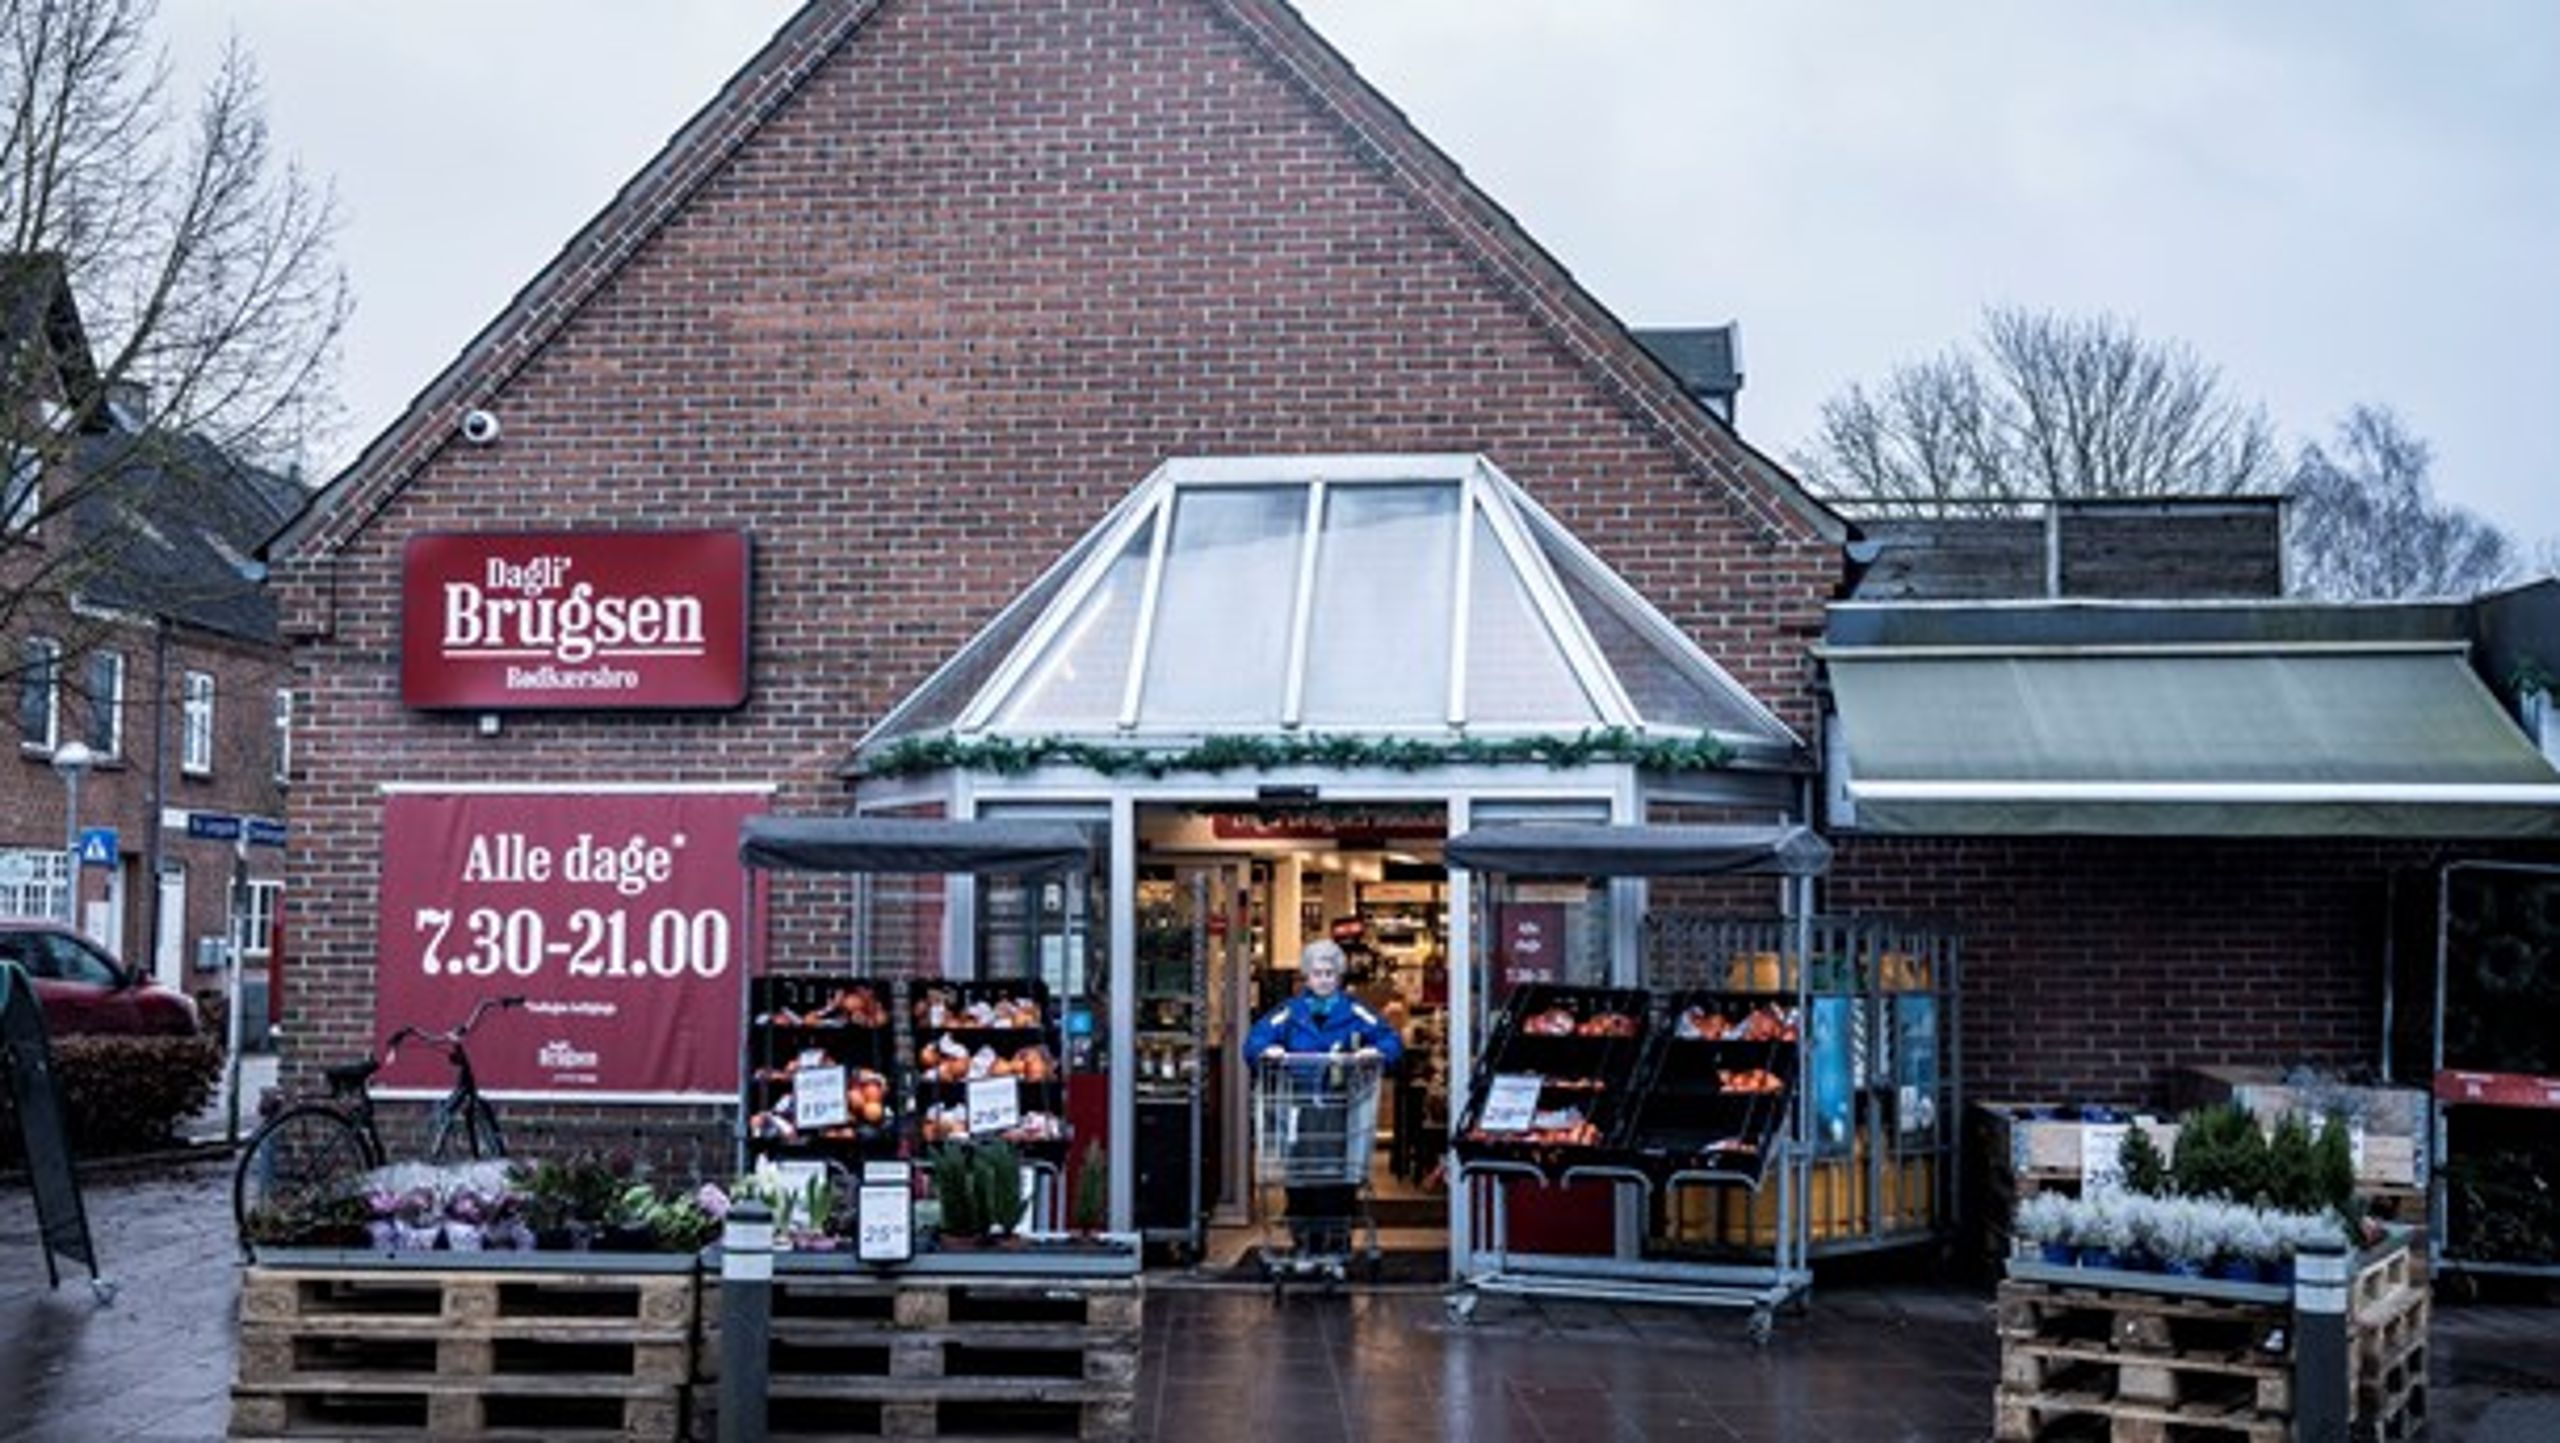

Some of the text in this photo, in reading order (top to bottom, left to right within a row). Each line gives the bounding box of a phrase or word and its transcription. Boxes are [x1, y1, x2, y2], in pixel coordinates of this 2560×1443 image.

[443, 583, 706, 663] Brugsen
[463, 833, 552, 883] Alle
[414, 908, 730, 978] 7.30-21.00
